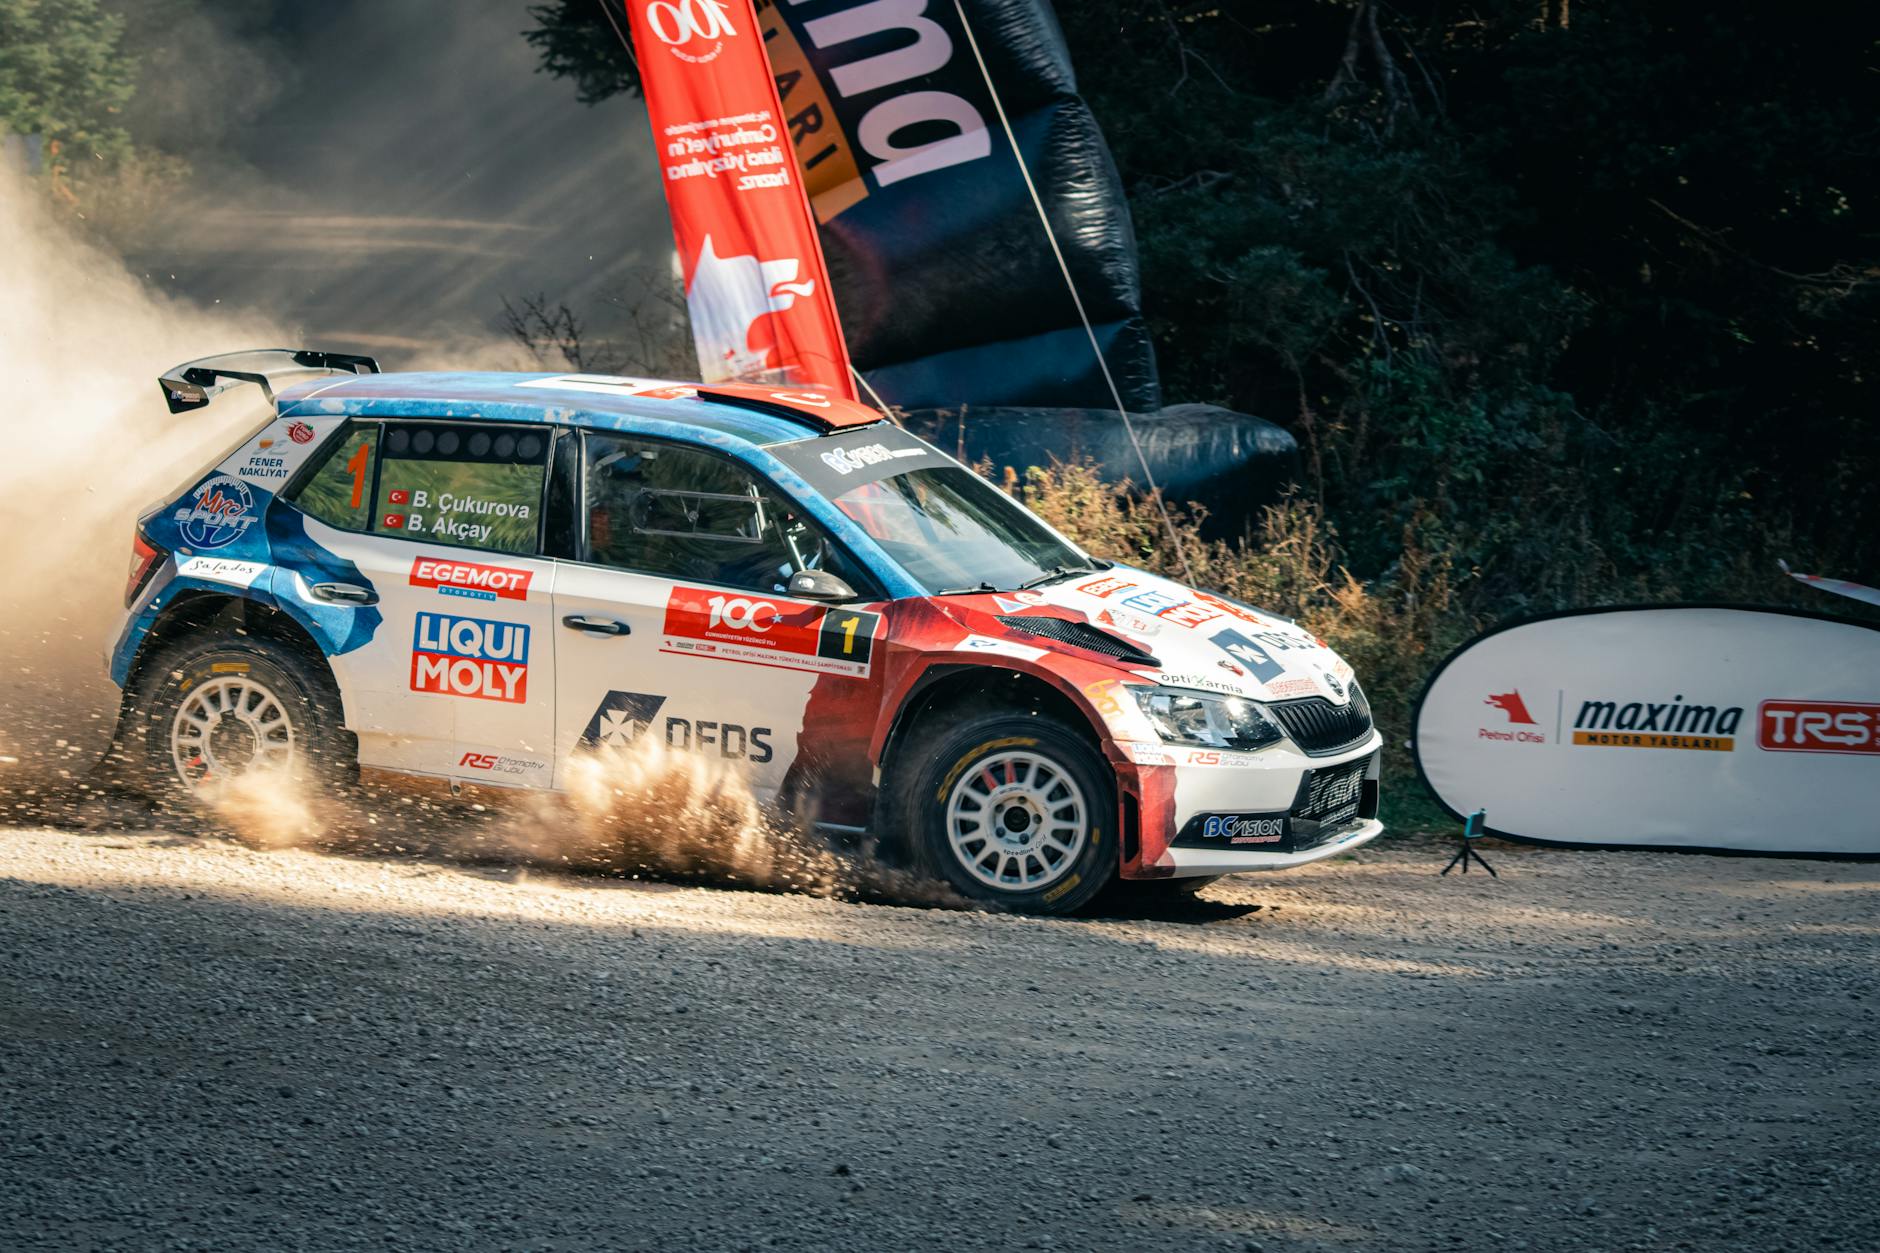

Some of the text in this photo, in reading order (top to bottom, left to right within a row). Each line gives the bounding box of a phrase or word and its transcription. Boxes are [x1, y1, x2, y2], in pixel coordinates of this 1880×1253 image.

[249, 457, 283, 467] FENER
[346, 443, 369, 509] 1
[413, 490, 530, 518] B. Çukurova
[174, 507, 258, 530] SPORT
[407, 514, 492, 542] B. Akçay
[416, 562, 525, 591] EGEMOT
[419, 615, 525, 660] LIQUI
[841, 616, 859, 654] 1
[416, 655, 526, 699] MOLY
[1574, 694, 1744, 735] maxima
[1765, 710, 1872, 745] TRS
[1478, 728, 1545, 744] Petrol Ofisi
[1587, 735, 1720, 750] MOTOR YAĞLARI
[459, 752, 498, 770] RS
[1188, 753, 1220, 765] RS
